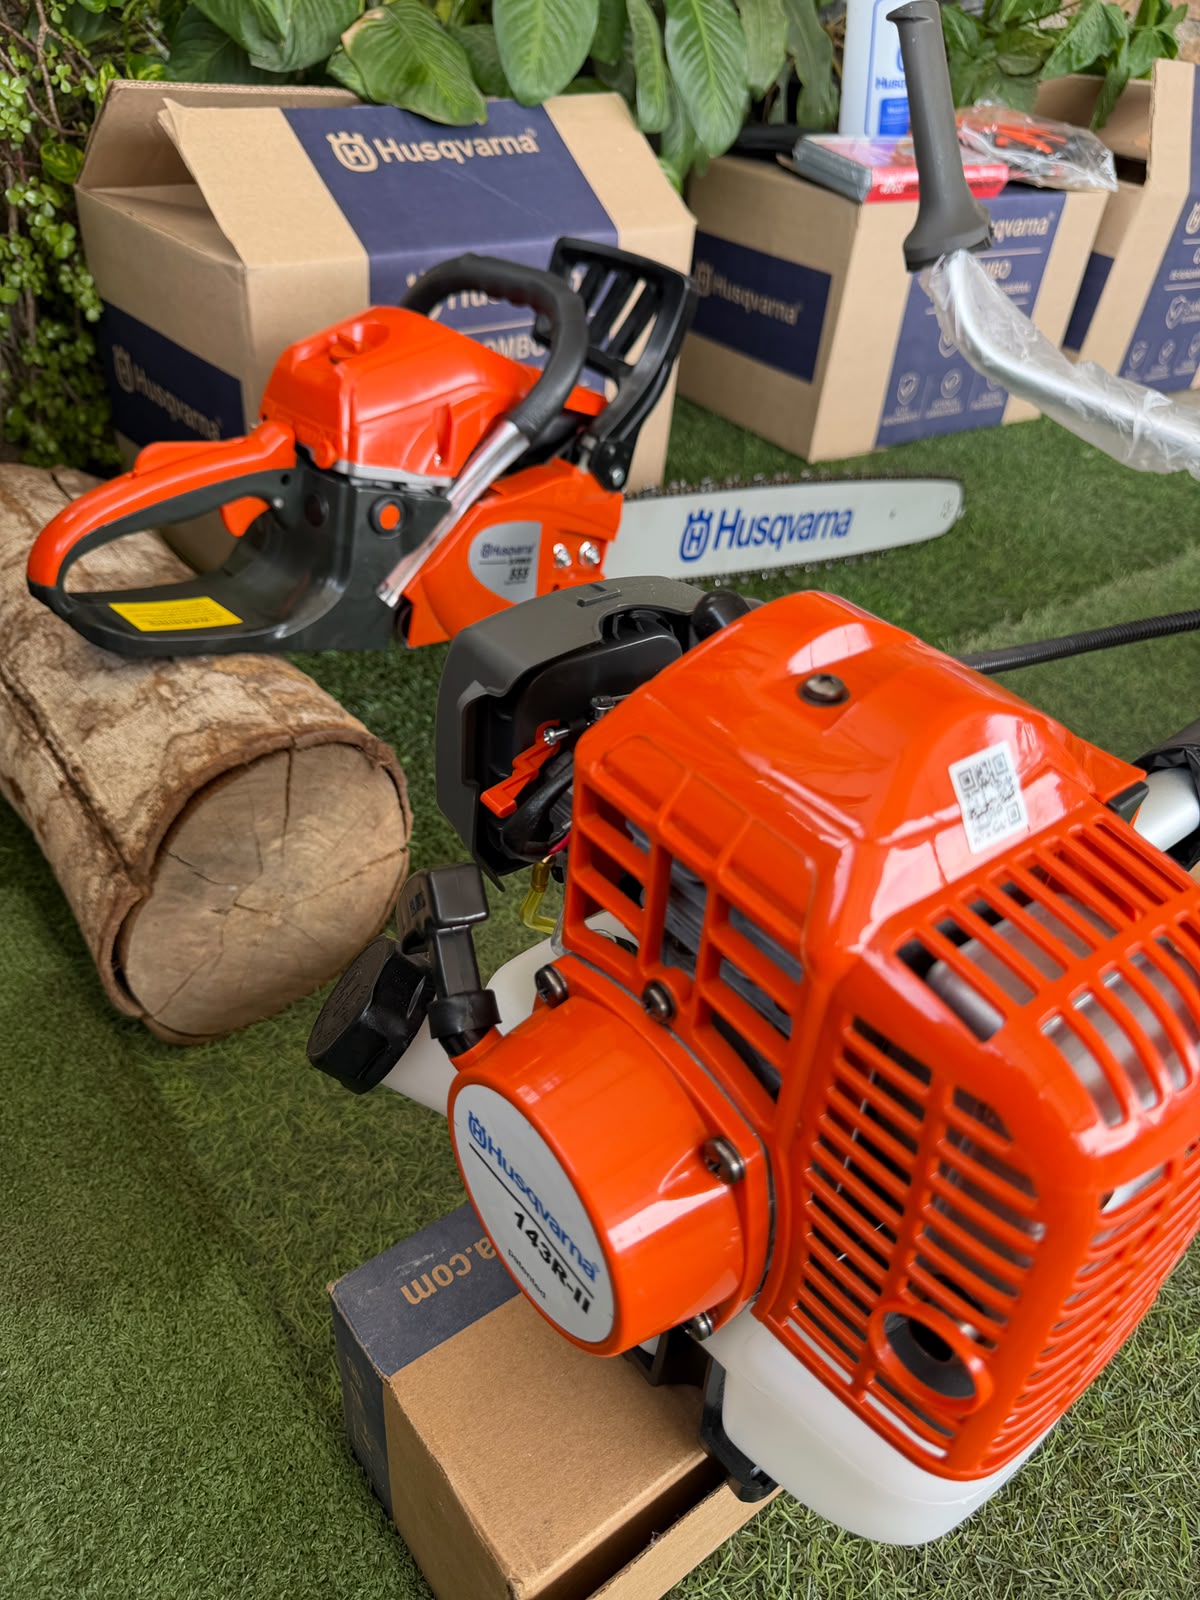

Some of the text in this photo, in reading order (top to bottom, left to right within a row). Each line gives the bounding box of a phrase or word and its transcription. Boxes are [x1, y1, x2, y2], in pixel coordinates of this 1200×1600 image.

[372, 134, 540, 165] Husqvarna
[714, 273, 798, 326] Husqvarna
[134, 363, 220, 443] Husqvarna
[713, 507, 853, 552] Husqvarna
[486, 1136, 598, 1283] Husqvarna
[400, 1236, 498, 1306] a.com
[513, 1210, 592, 1315] 143R-II
